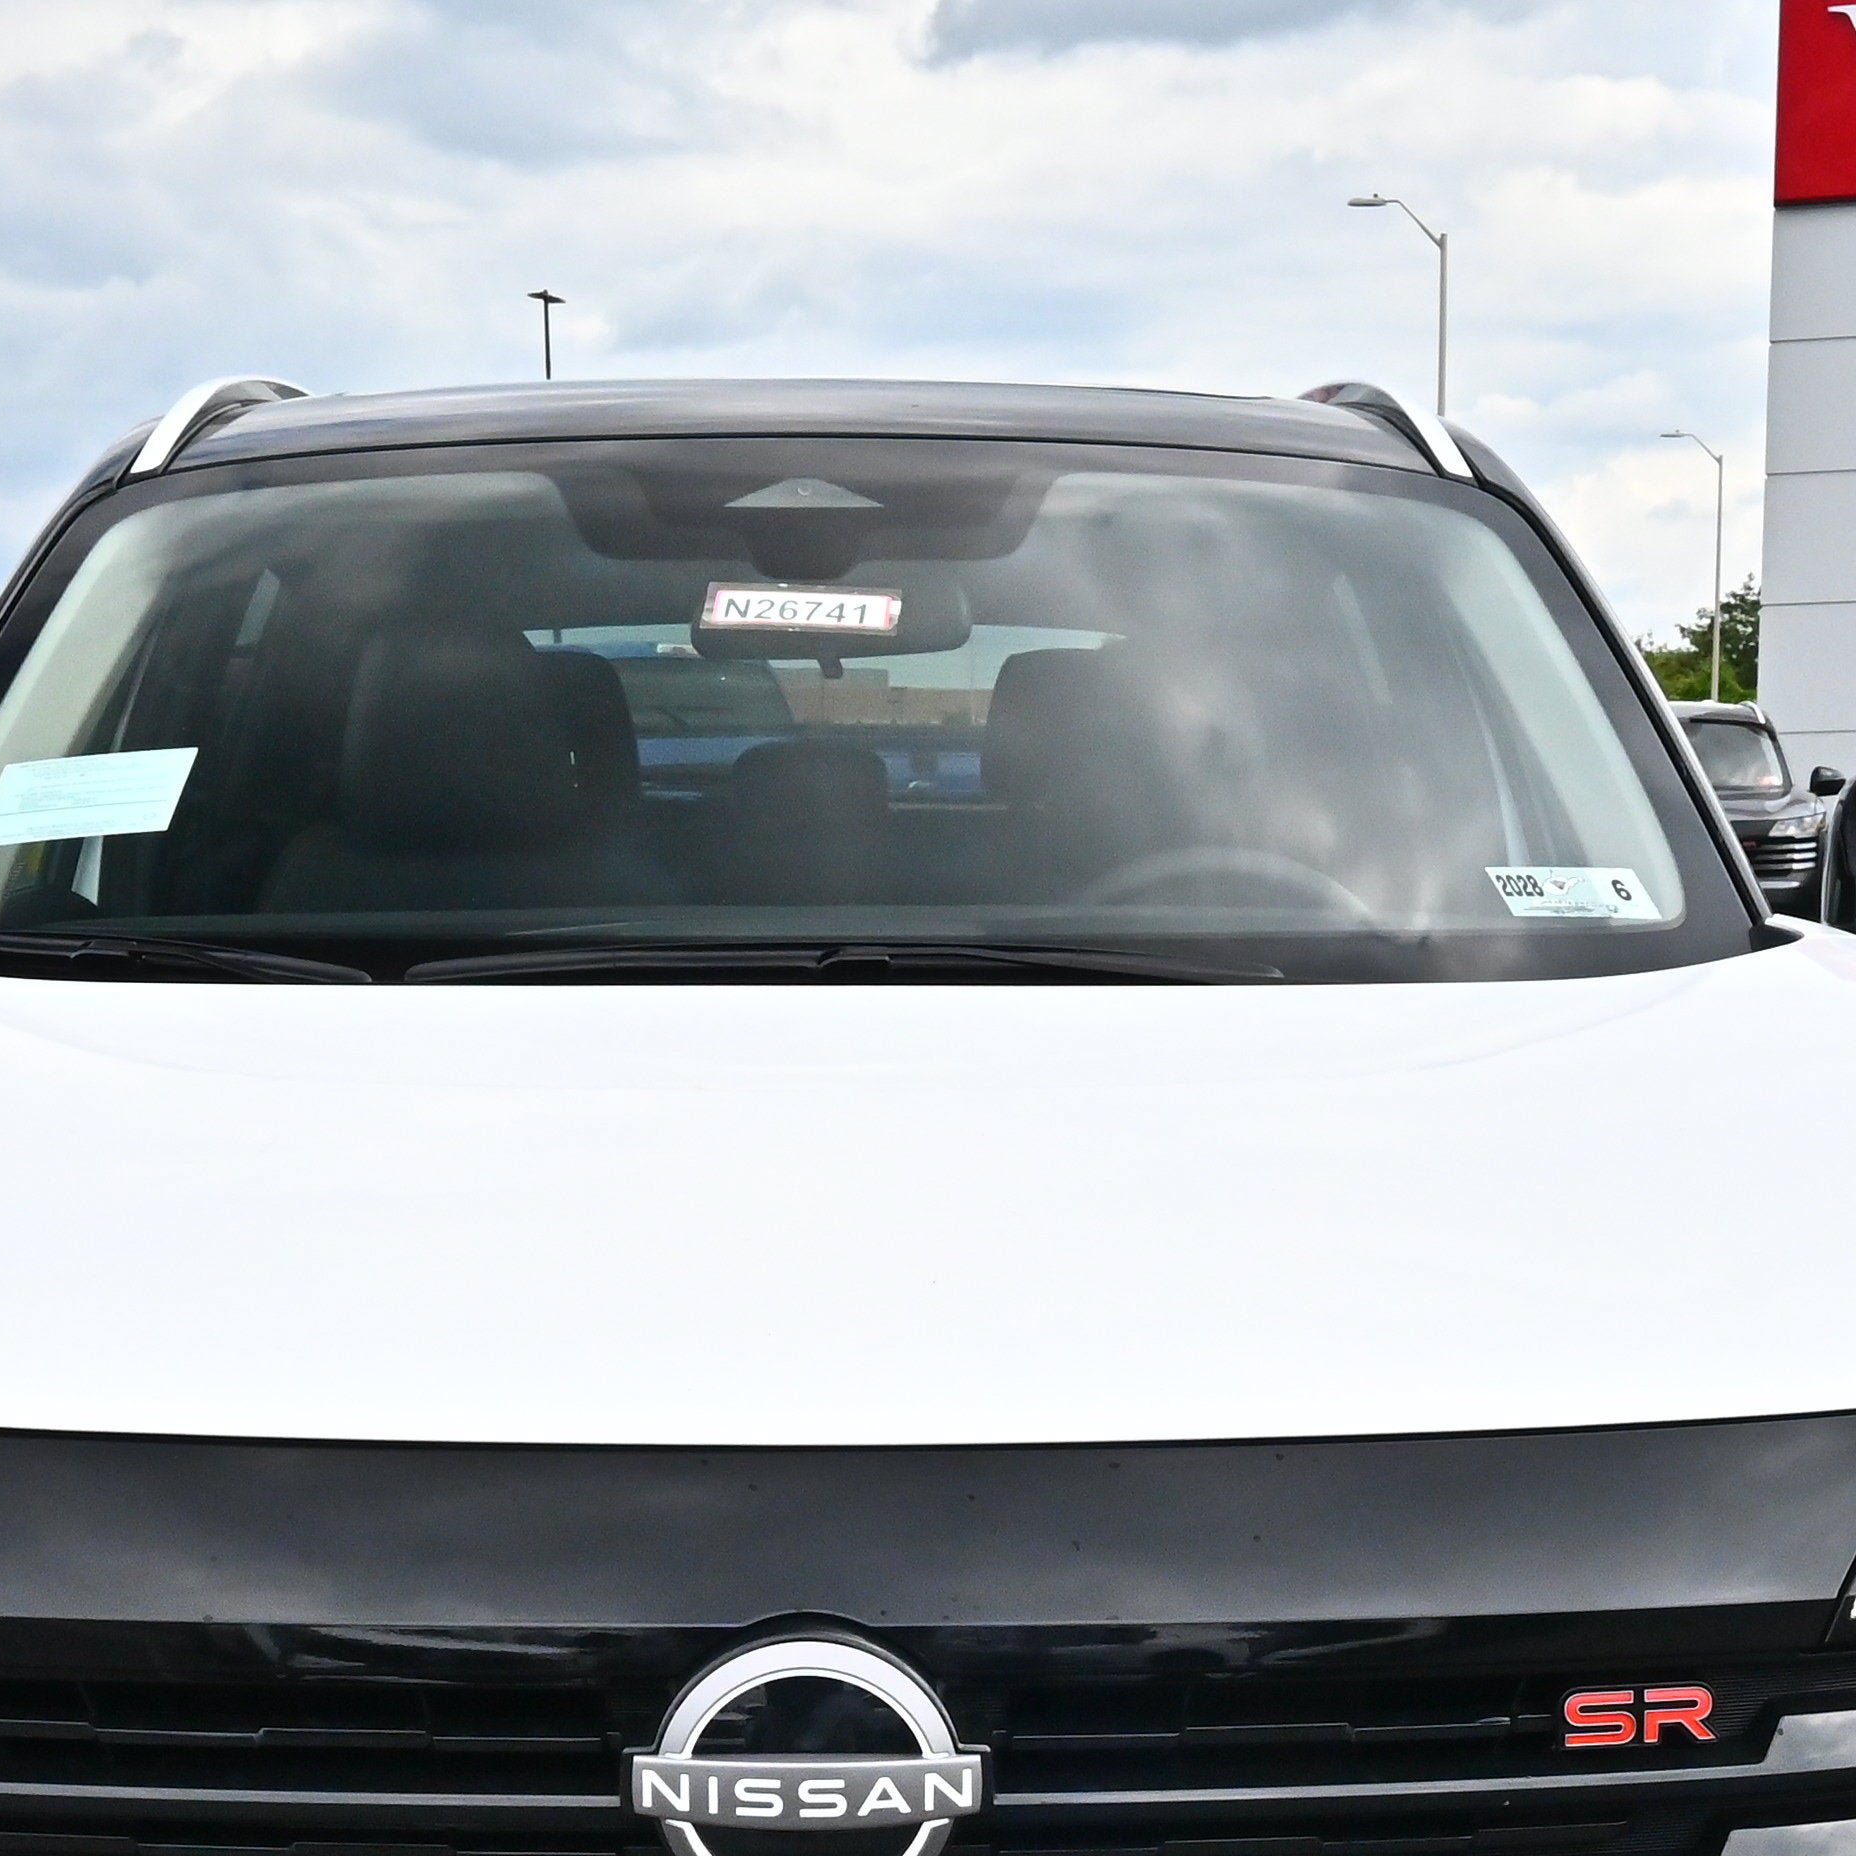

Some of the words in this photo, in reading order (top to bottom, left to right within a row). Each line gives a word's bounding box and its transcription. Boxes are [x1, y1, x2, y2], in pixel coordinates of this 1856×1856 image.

[724, 598, 868, 624] N26741
[1495, 874, 1545, 898] 2028
[1611, 879, 1633, 901] 6
[1564, 1686, 1717, 1748] SR
[641, 1767, 973, 1819] NISSAN
